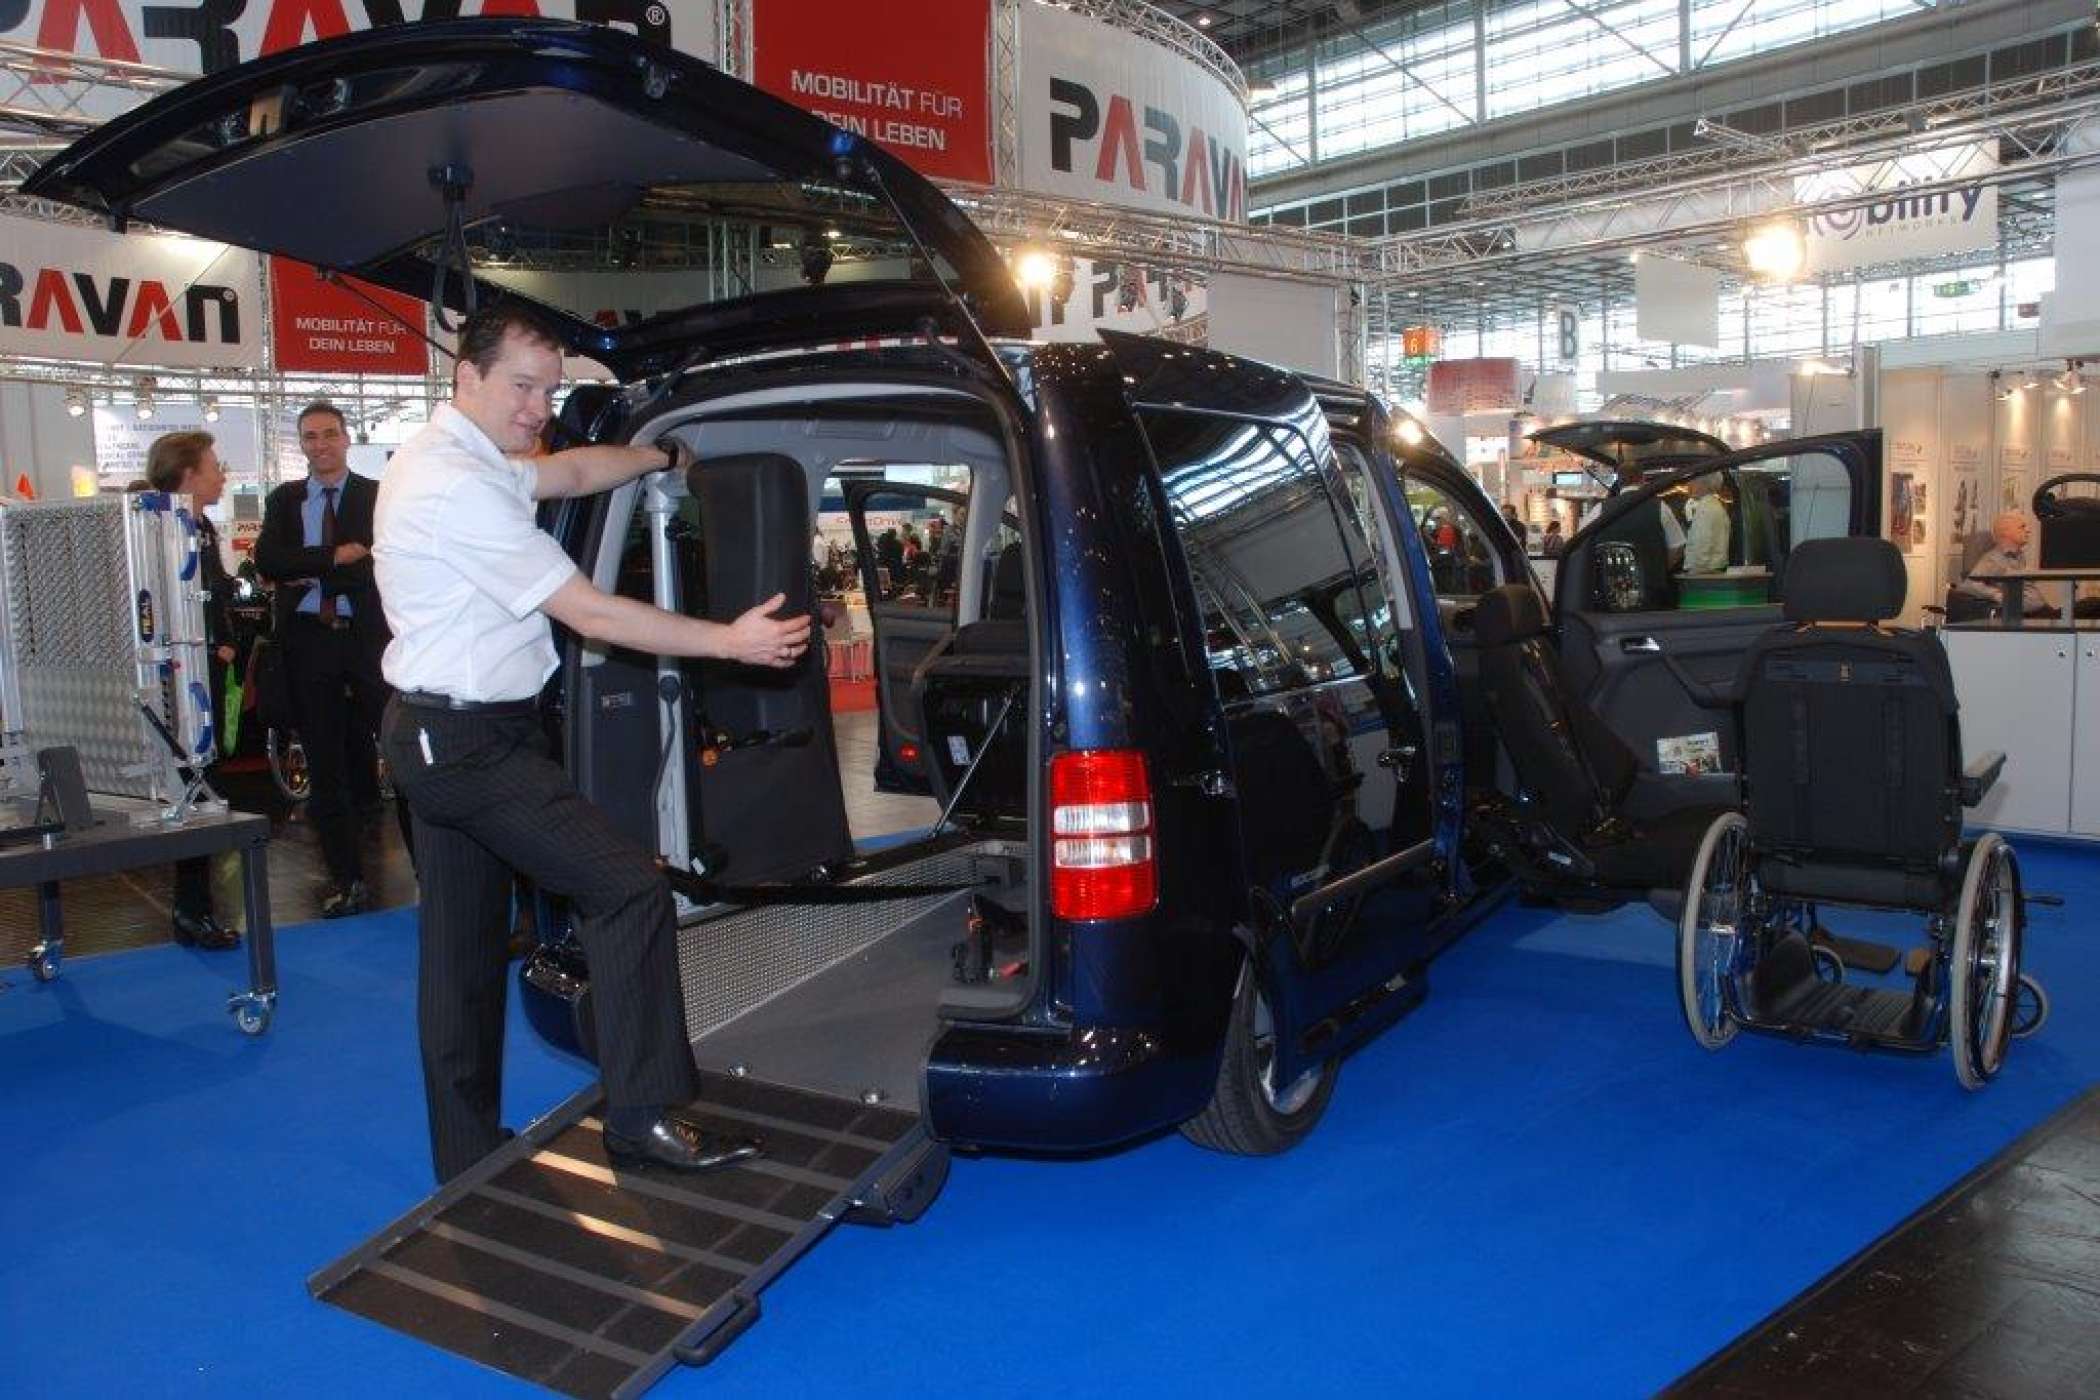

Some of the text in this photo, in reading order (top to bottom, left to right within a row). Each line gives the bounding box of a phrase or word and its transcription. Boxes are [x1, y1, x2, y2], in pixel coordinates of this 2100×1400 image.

[791, 69, 914, 110] MOBILITÄT
[811, 109, 945, 150] EIN LEBEN
[1050, 77, 1249, 224] PARAVA
[296, 316, 376, 334] MOBILITÄT
[309, 337, 396, 354] DEIN LEBEN
[1560, 311, 1578, 359] B
